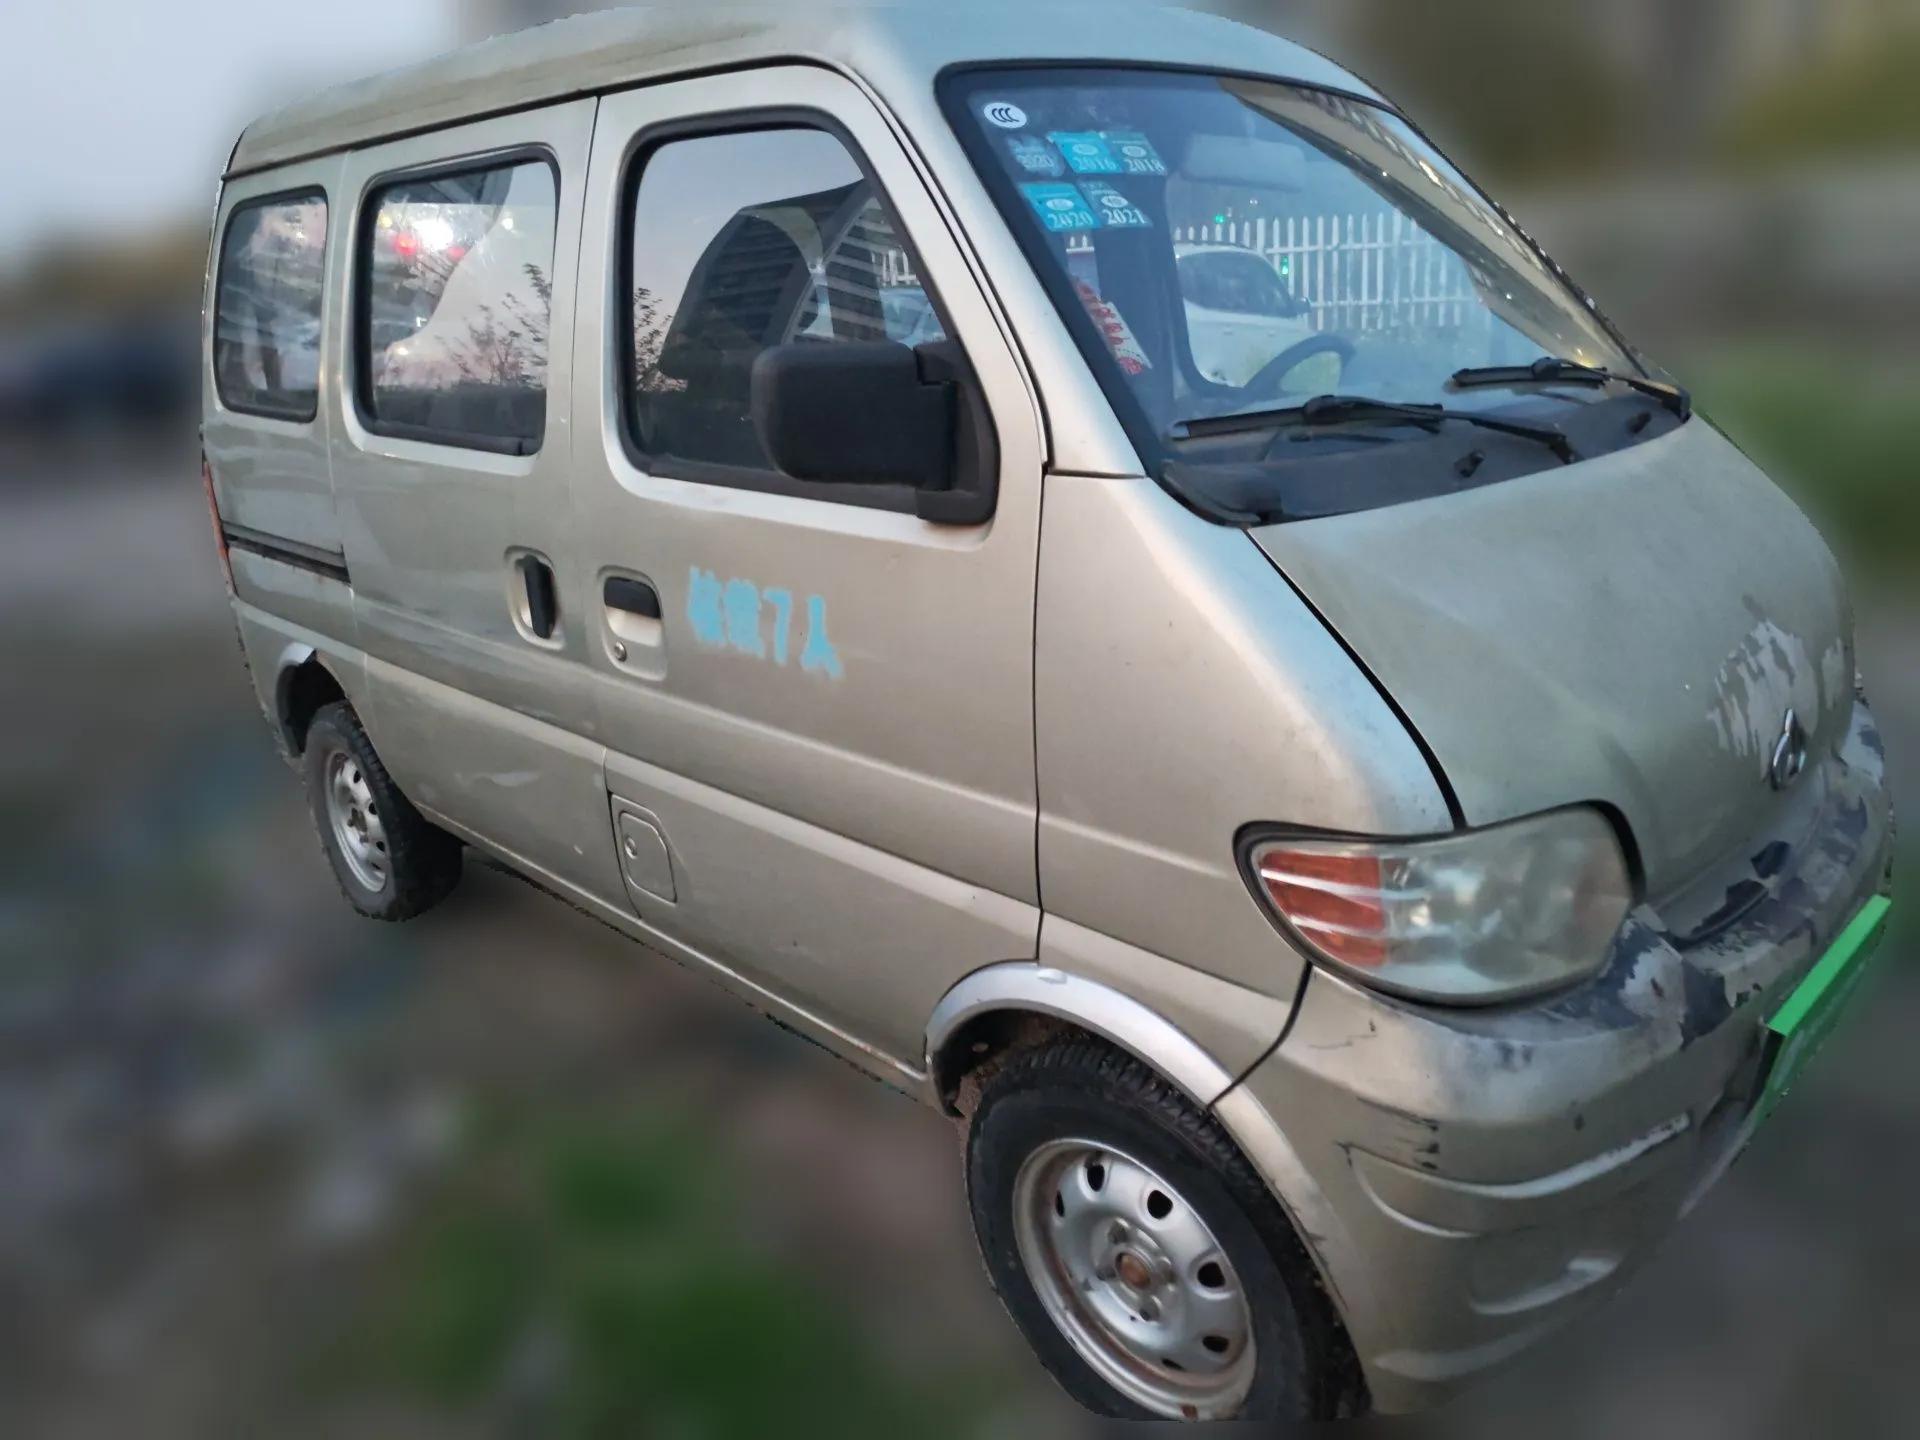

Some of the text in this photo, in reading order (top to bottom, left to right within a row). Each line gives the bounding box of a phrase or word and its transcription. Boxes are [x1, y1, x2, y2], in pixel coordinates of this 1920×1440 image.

[1125, 157, 1165, 174] 2018
[1047, 210, 1094, 228] 2020
[1103, 208, 1146, 225] 2021
